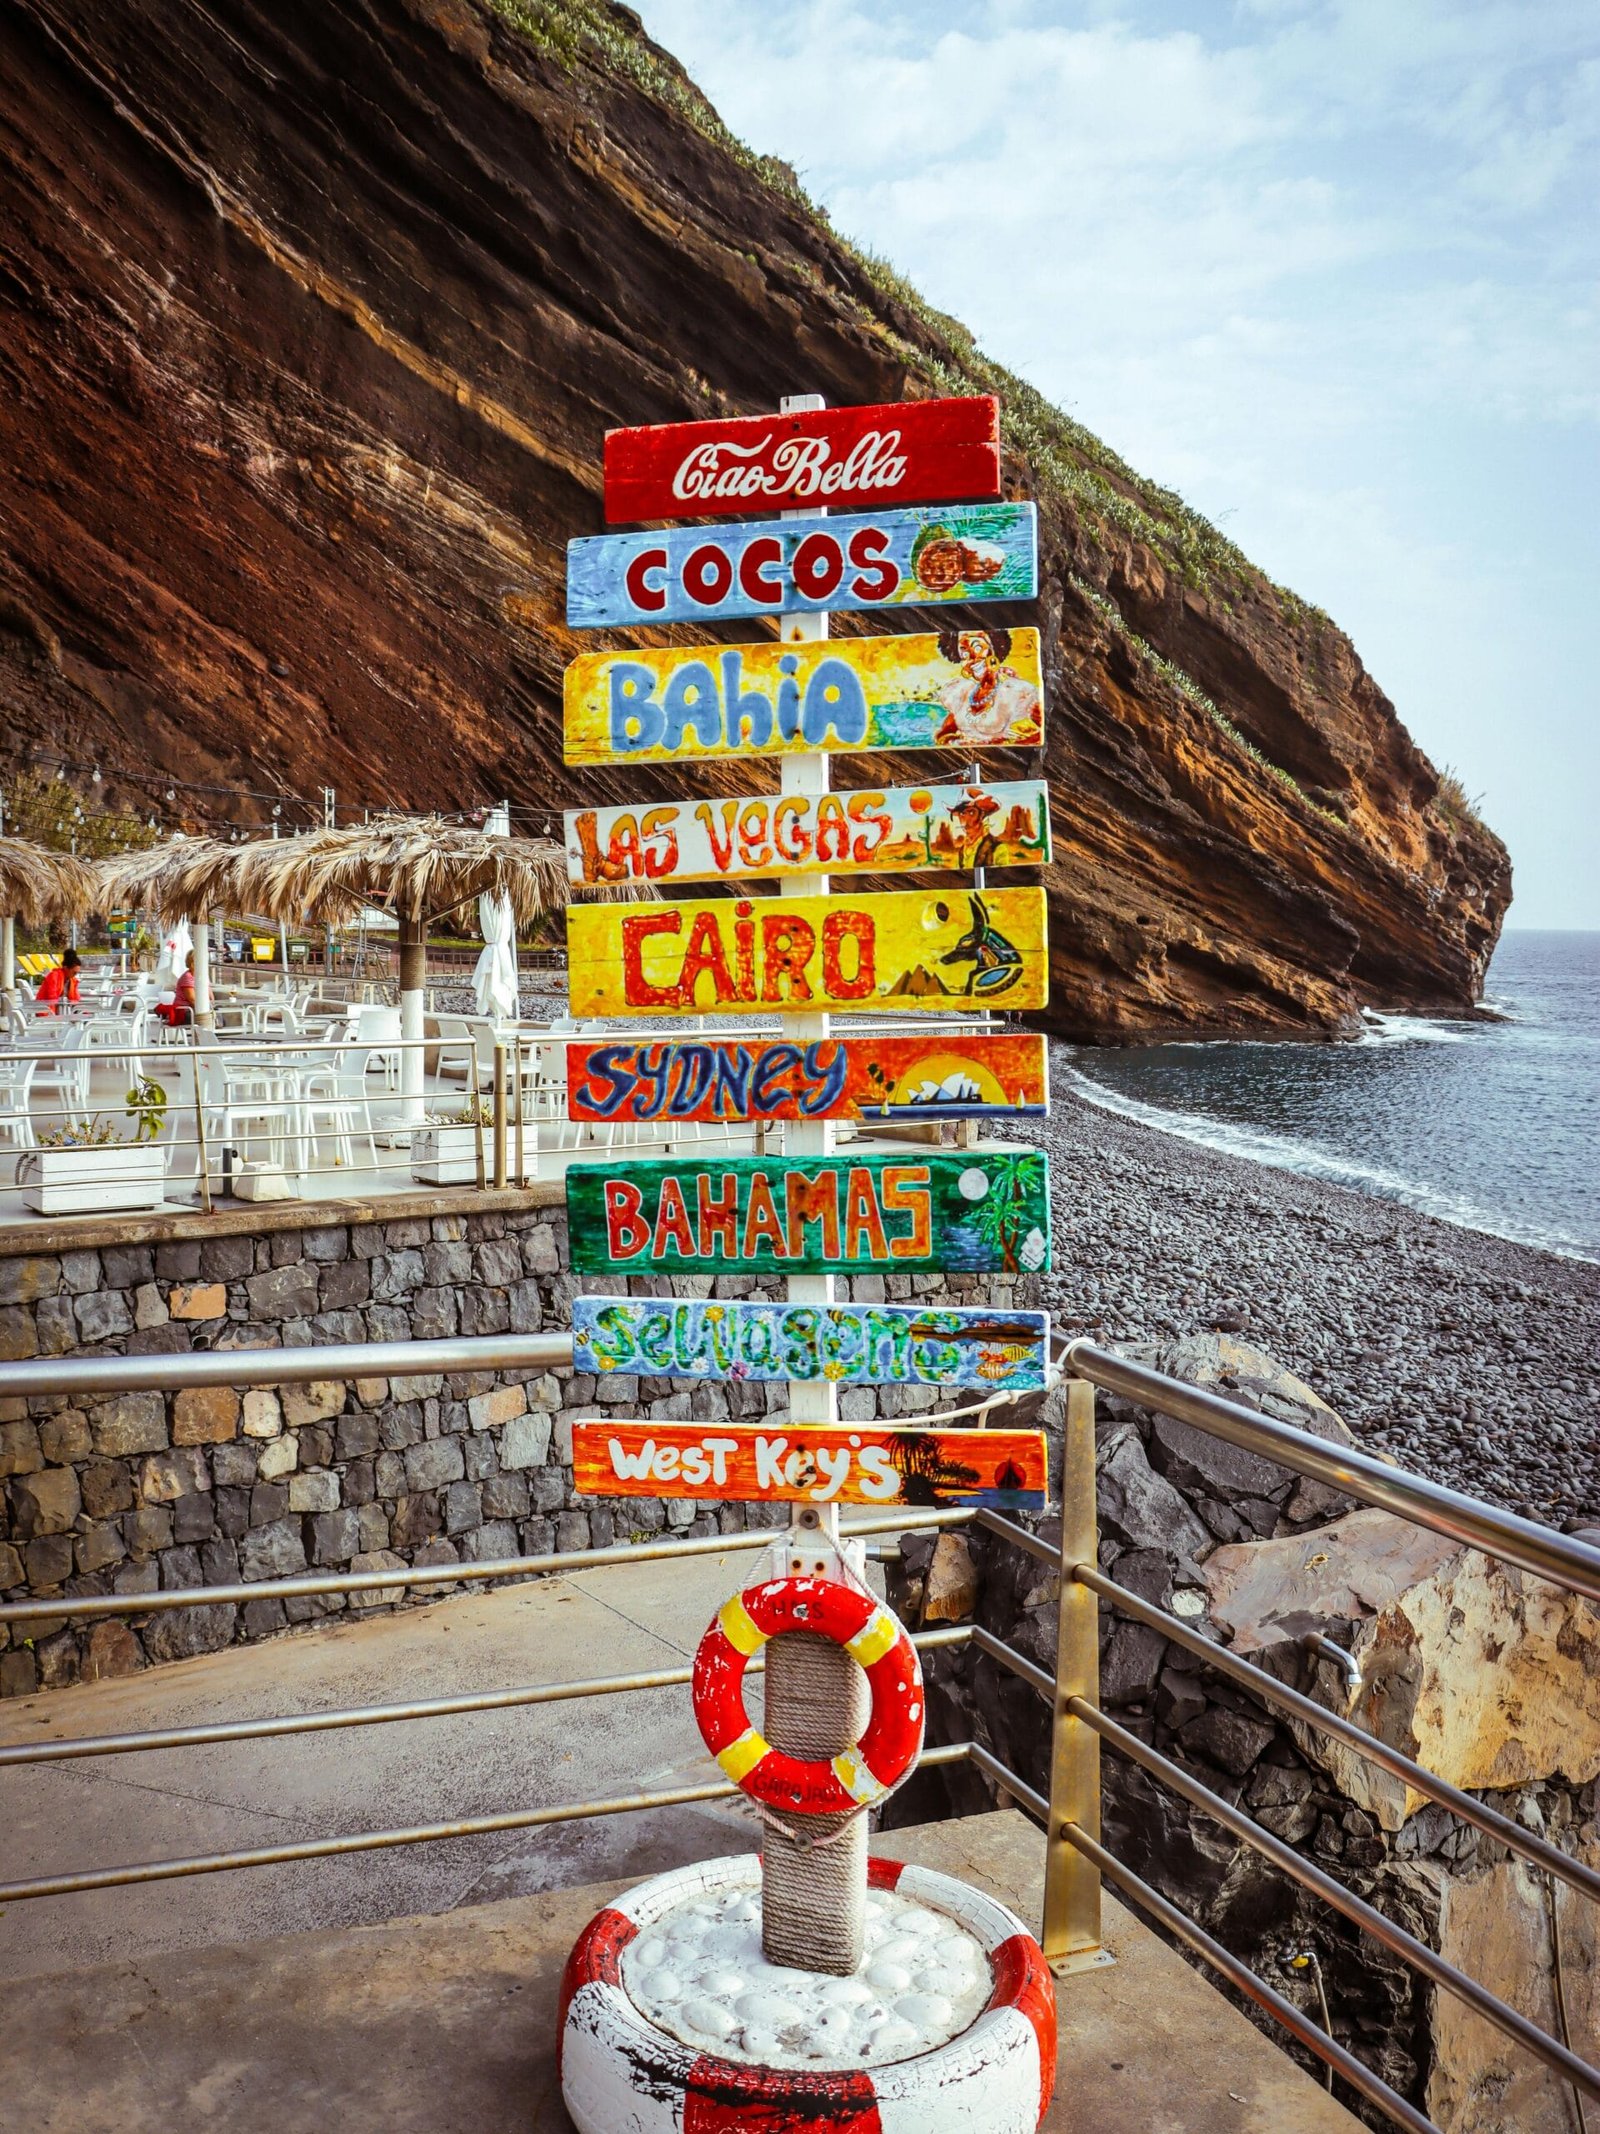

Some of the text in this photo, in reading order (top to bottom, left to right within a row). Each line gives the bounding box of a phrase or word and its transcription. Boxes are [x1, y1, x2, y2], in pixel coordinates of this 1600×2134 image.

[672, 430, 908, 499] Ciao Bella
[626, 527, 900, 612] COCOS
[575, 807, 679, 882] LAS
[603, 1166, 933, 1260] BAHAMAS
